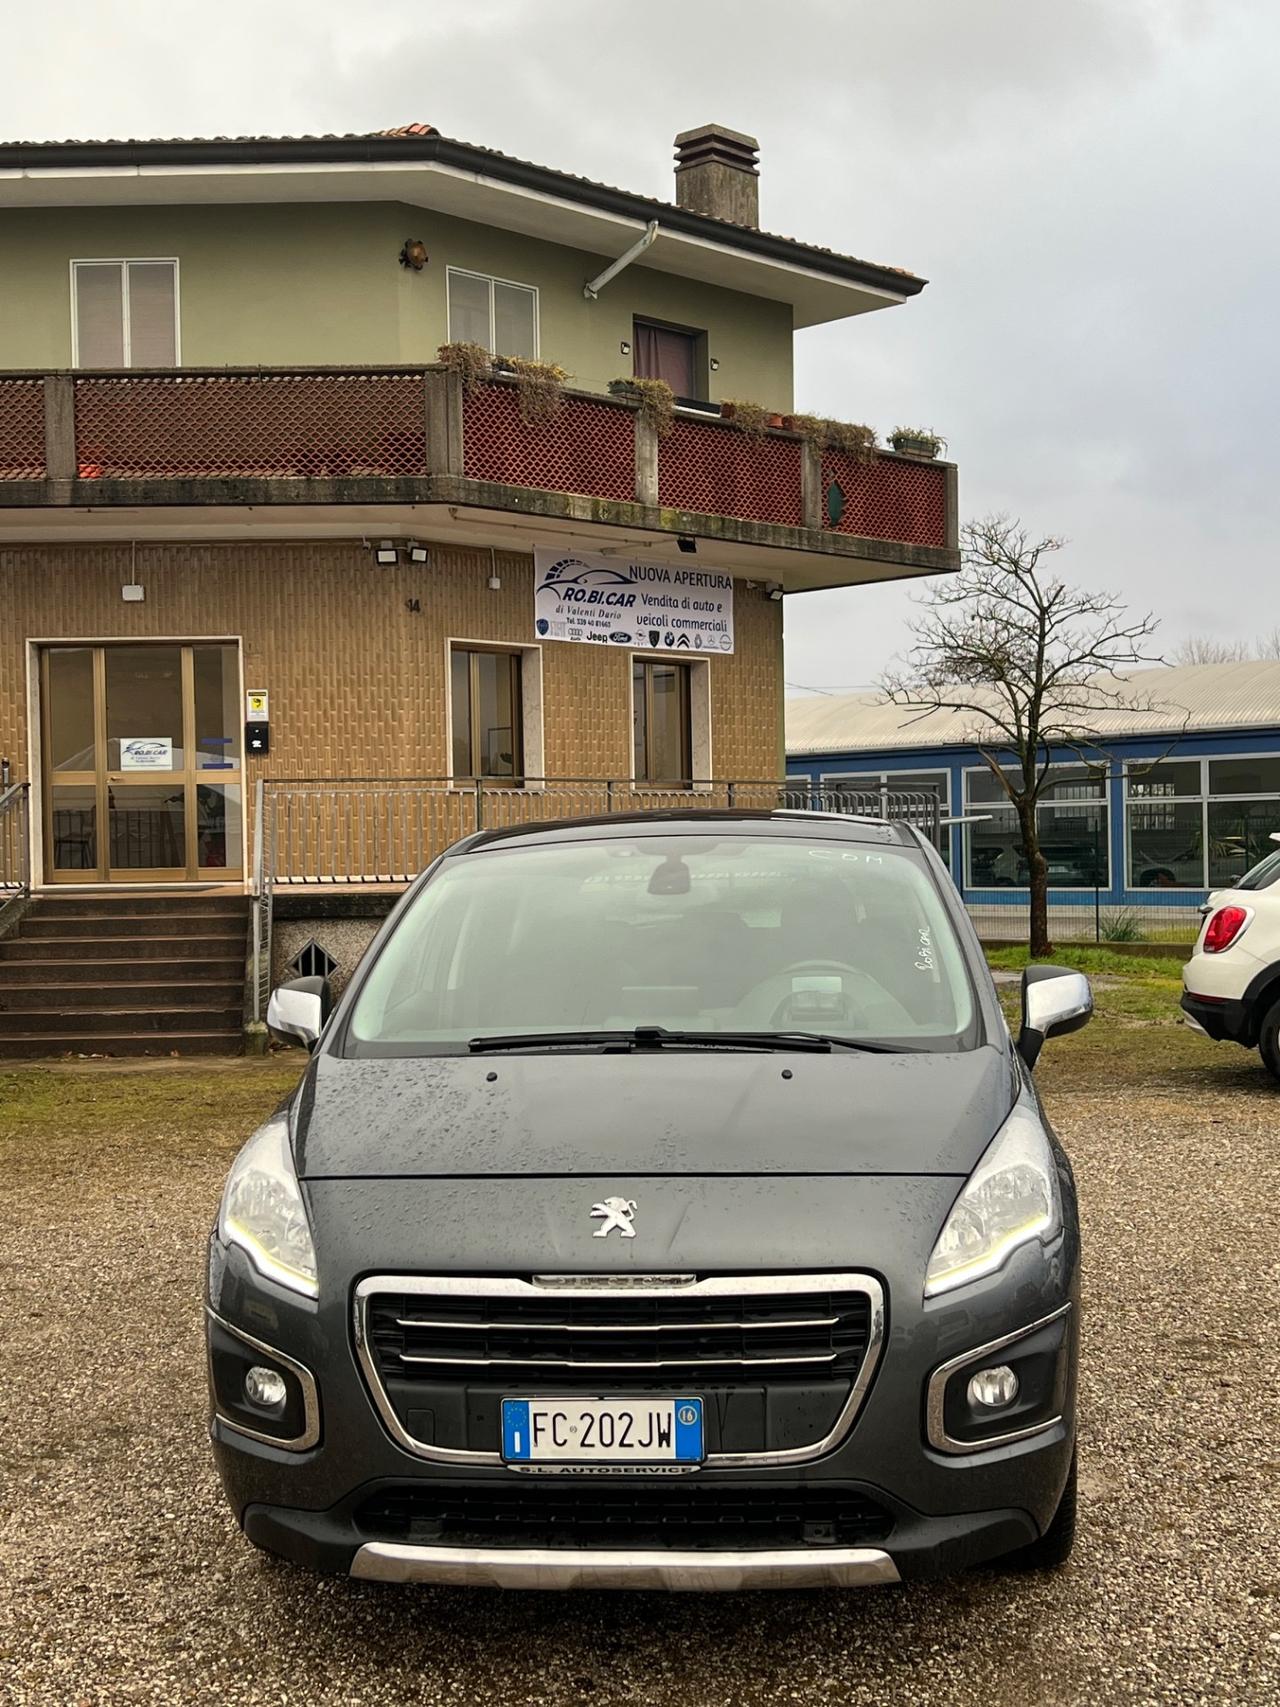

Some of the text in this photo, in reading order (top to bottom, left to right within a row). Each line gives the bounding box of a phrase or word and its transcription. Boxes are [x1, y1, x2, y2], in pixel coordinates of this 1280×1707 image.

[629, 565, 733, 590] NUOVA APERTURA
[562, 587, 636, 608] RO.BI.CAR
[641, 593, 723, 613] Vendita di auto e
[555, 605, 622, 620] di Valenti Dario
[636, 613, 728, 632] veicoli commerciali
[586, 631, 608, 644] Jeep
[681, 1411, 693, 1421] 16
[532, 1412, 568, 1448] FC
[580, 1412, 671, 1448] 202JW
